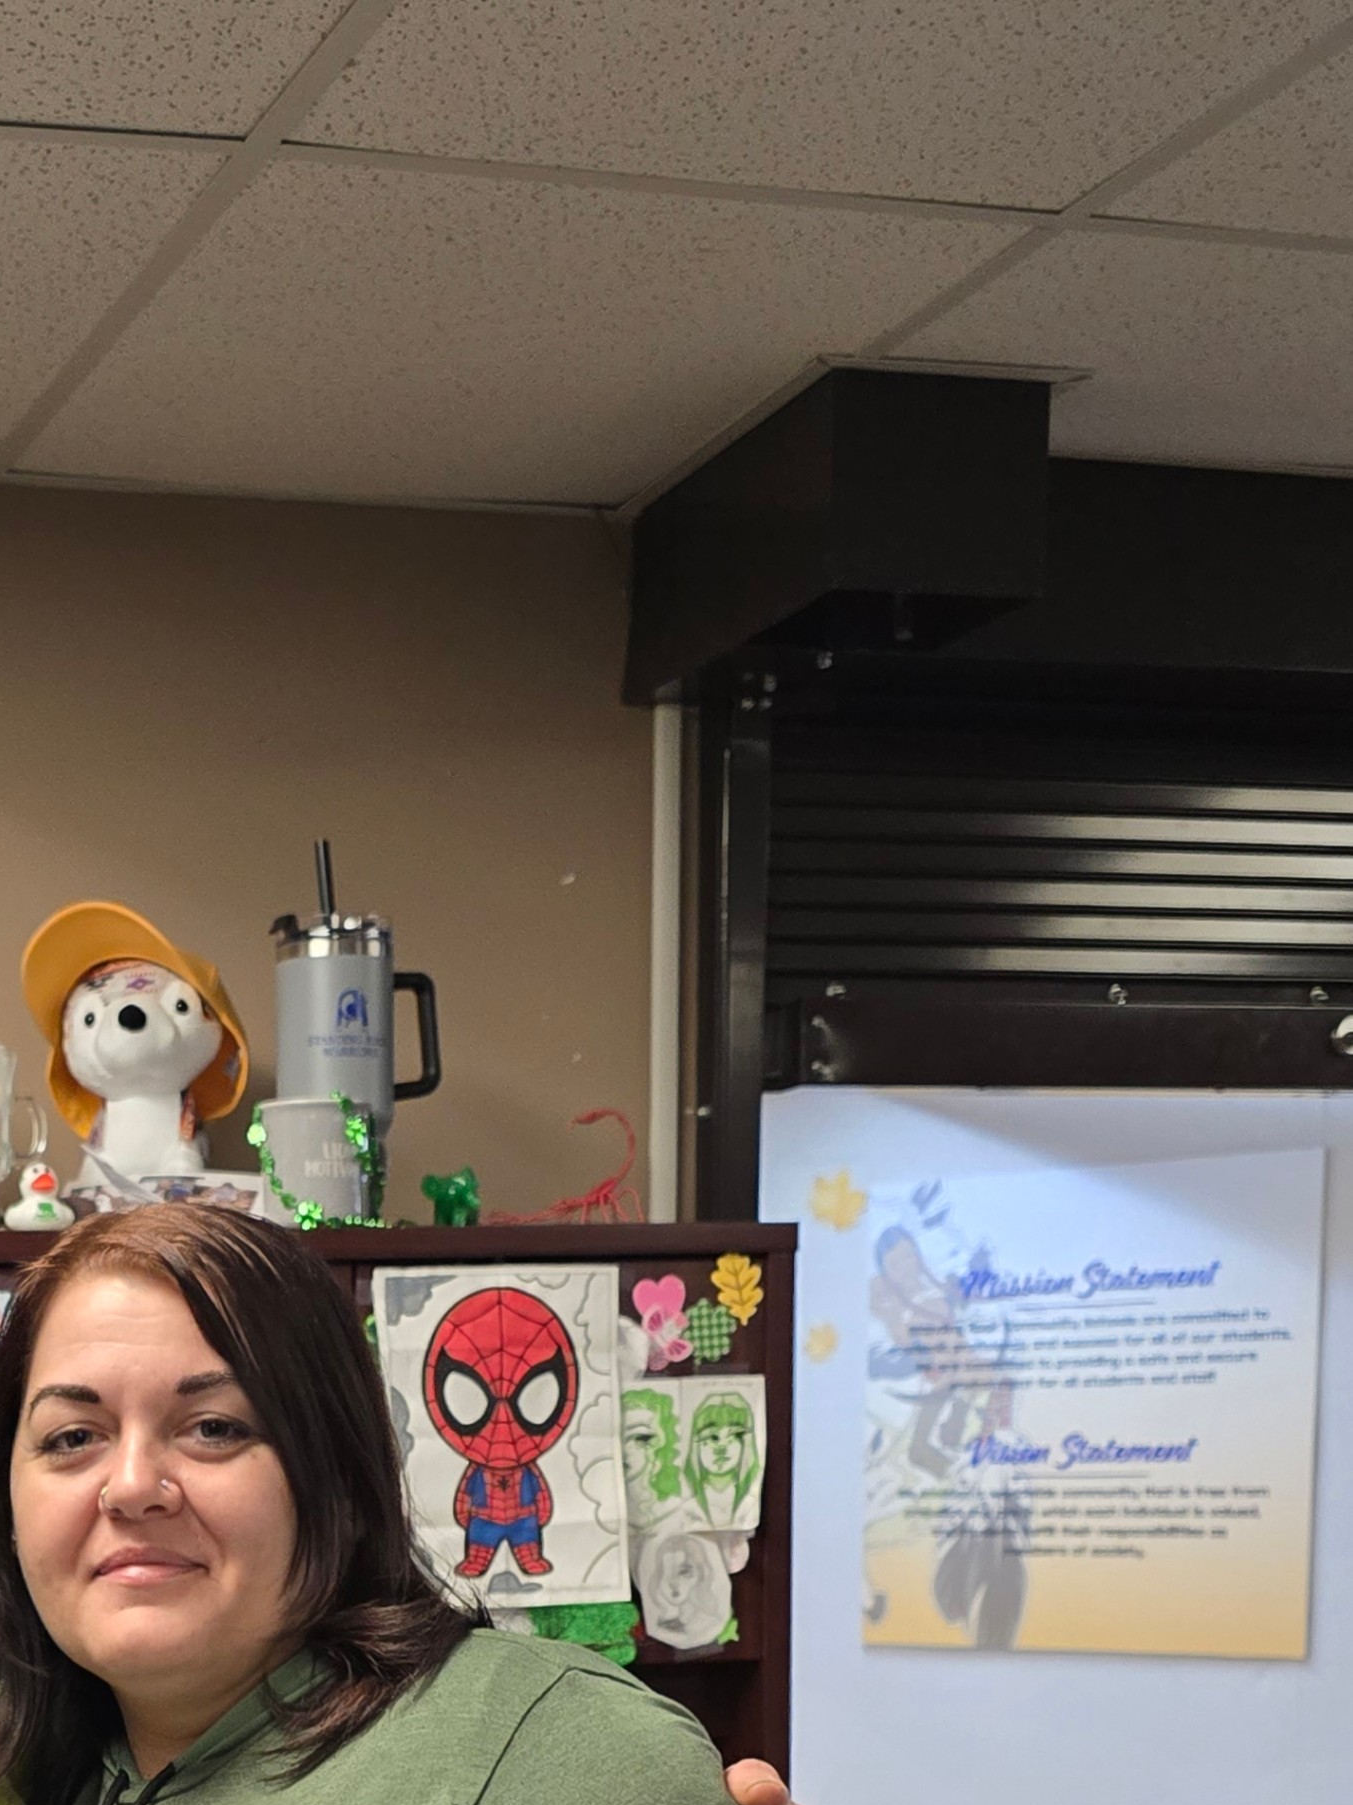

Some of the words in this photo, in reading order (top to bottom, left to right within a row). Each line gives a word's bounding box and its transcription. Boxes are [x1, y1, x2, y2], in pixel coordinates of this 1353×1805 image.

[962, 1267, 1074, 1298] Mission
[1076, 1260, 1220, 1299] Statement
[968, 1436, 1050, 1467] Vision
[1058, 1432, 1197, 1470] Statement
